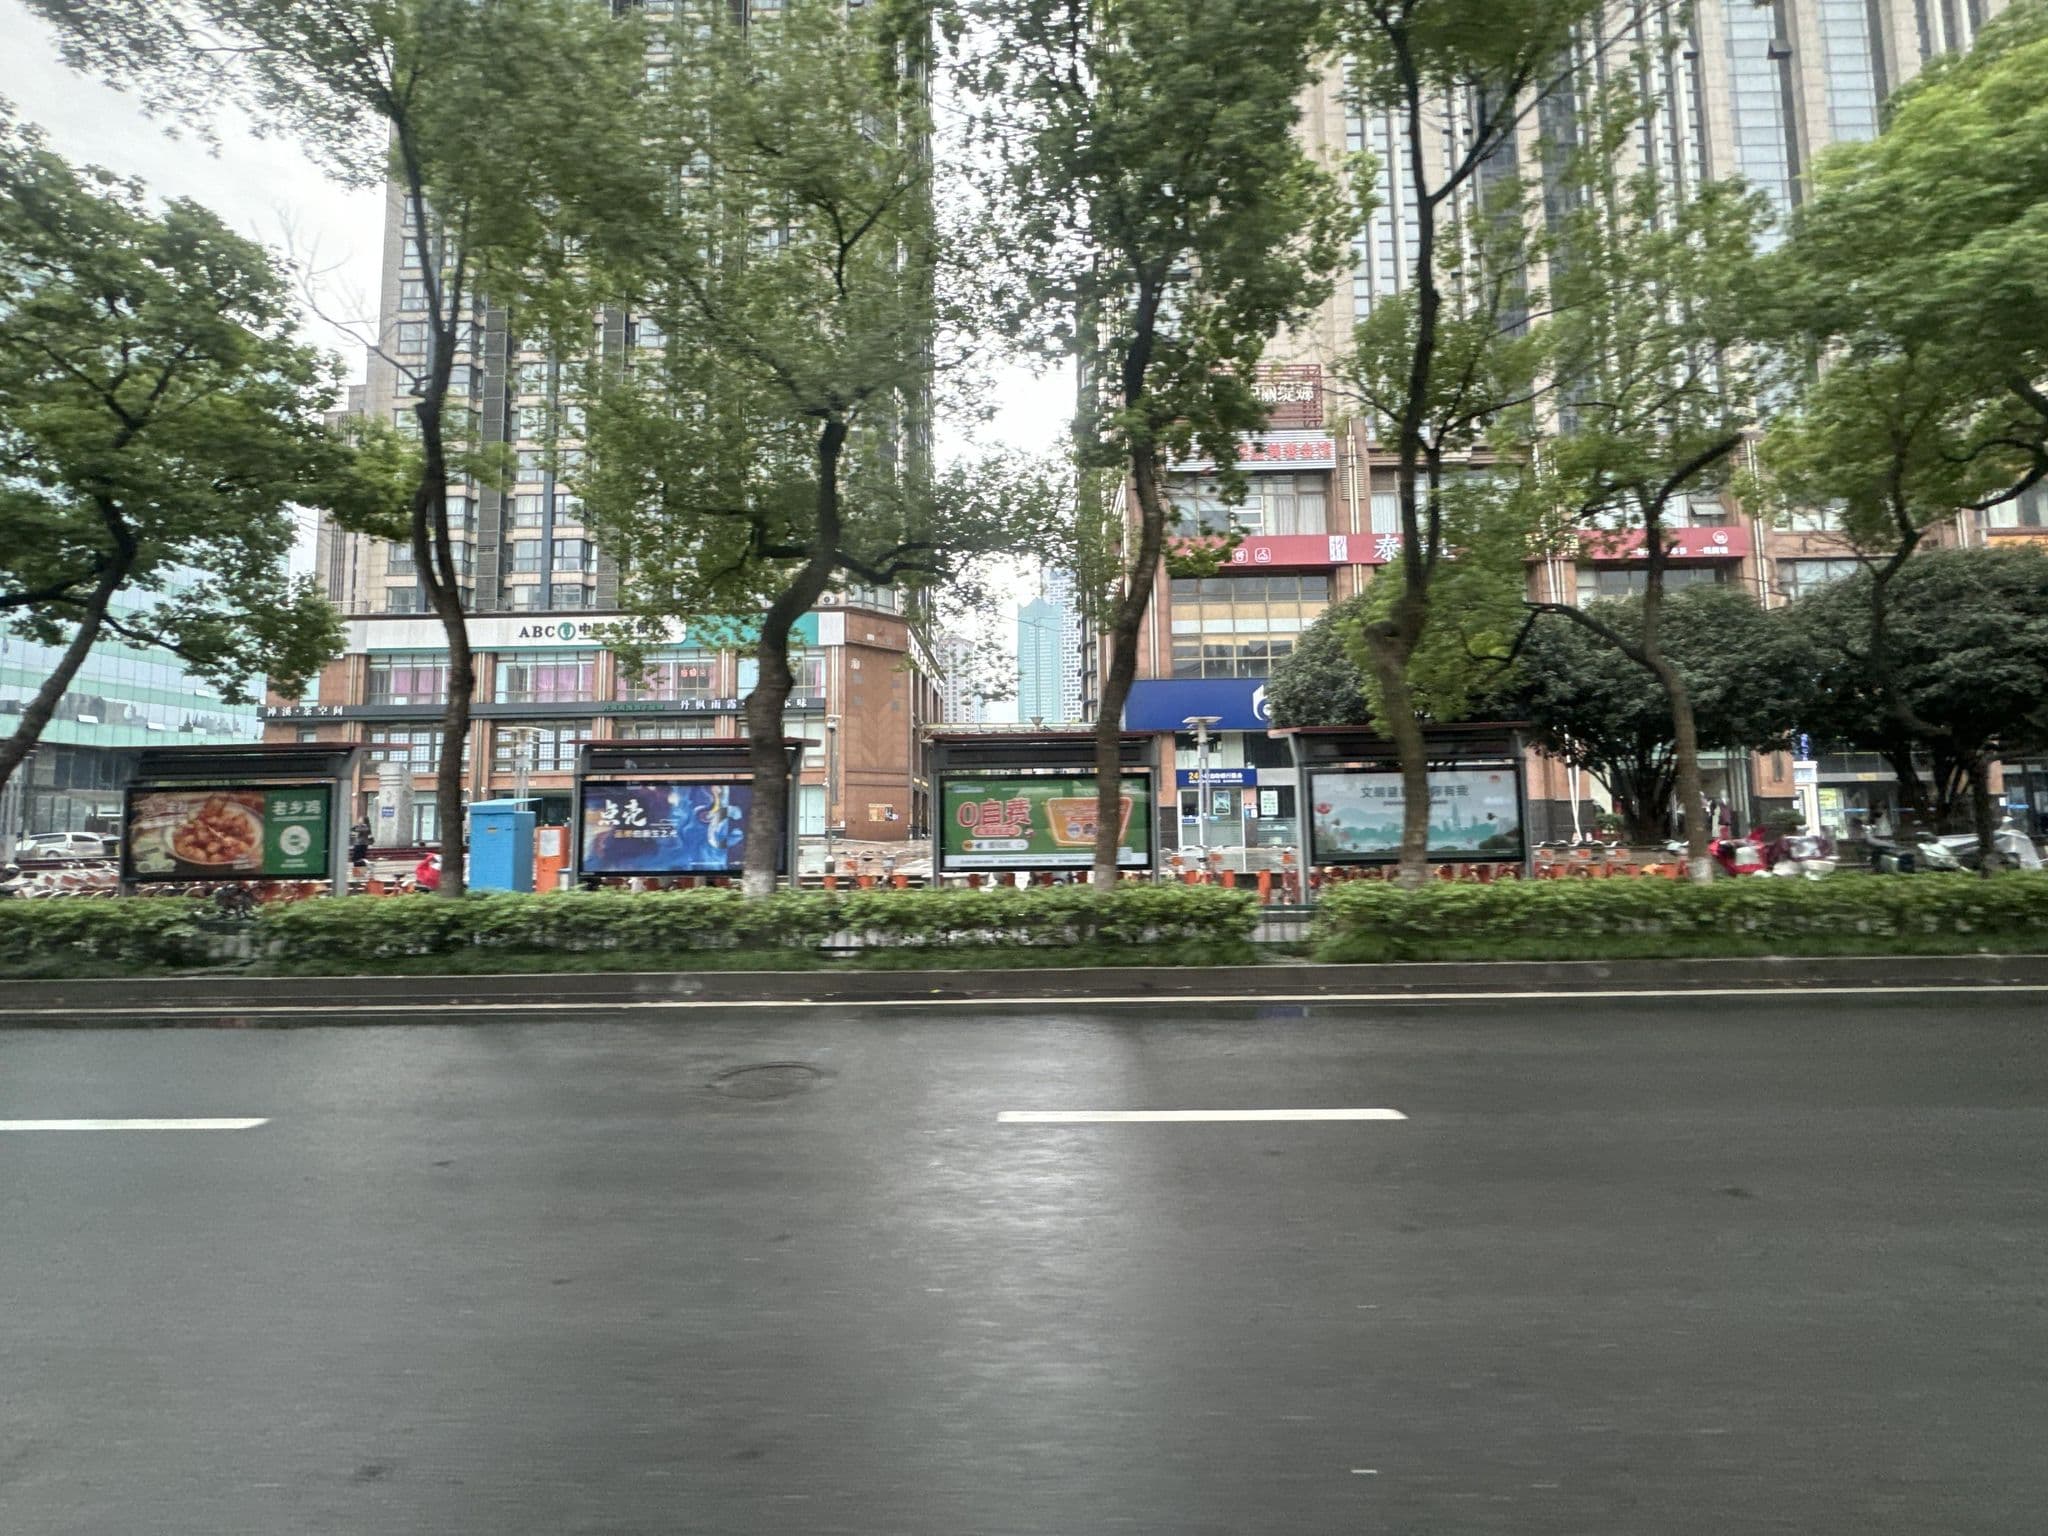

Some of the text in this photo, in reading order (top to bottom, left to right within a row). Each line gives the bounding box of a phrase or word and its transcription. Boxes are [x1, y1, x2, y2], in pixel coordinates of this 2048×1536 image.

[519, 625, 555, 638] ABC
[579, 622, 669, 637] 中国农业银
[272, 800, 321, 815] 老乡鸡
[598, 798, 647, 827] 点亮
[957, 796, 1032, 827] 0自费
